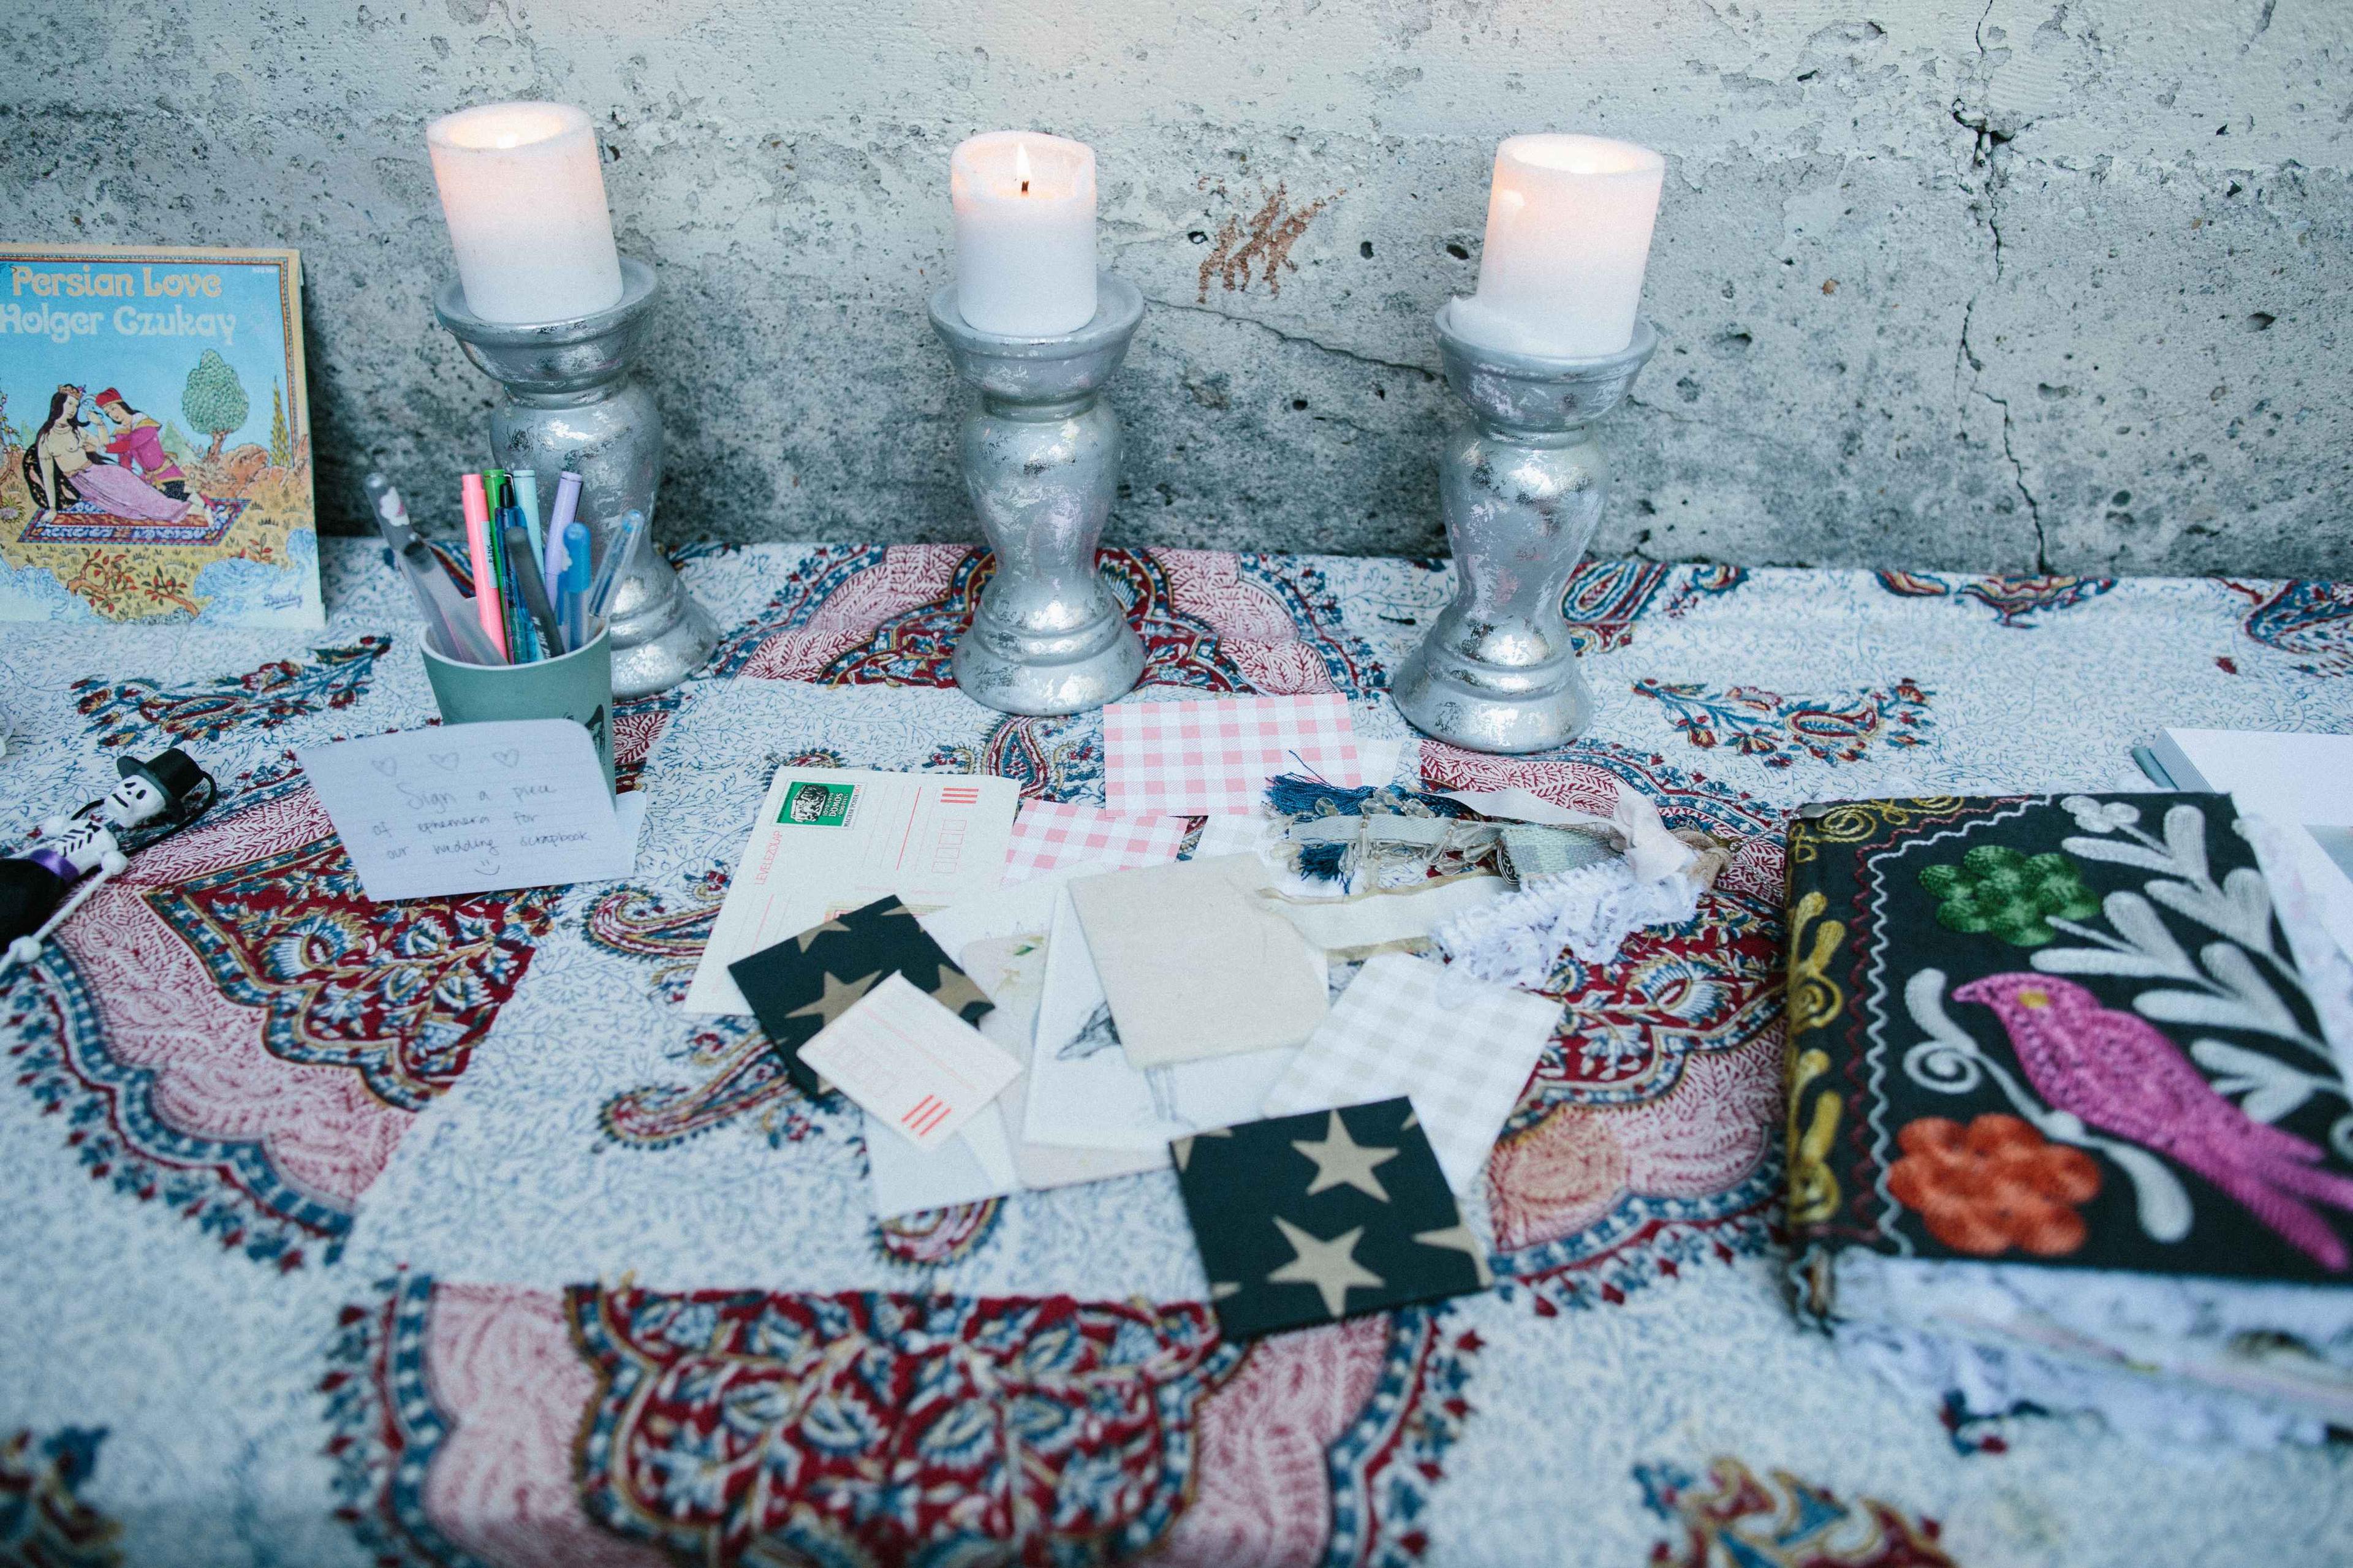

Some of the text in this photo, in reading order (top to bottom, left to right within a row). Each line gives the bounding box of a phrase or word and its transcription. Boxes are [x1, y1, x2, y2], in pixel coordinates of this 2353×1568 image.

[12, 265, 222, 298] Persian Love
[0, 303, 237, 346] Holger Czukay
[396, 782, 457, 814] Sign
[479, 790, 491, 801] a
[844, 809, 854, 827] MAGYAR
[850, 794, 859, 808] POSTA
[373, 811, 539, 838] of ephemera for
[387, 831, 593, 859] our wedding scrapbook
